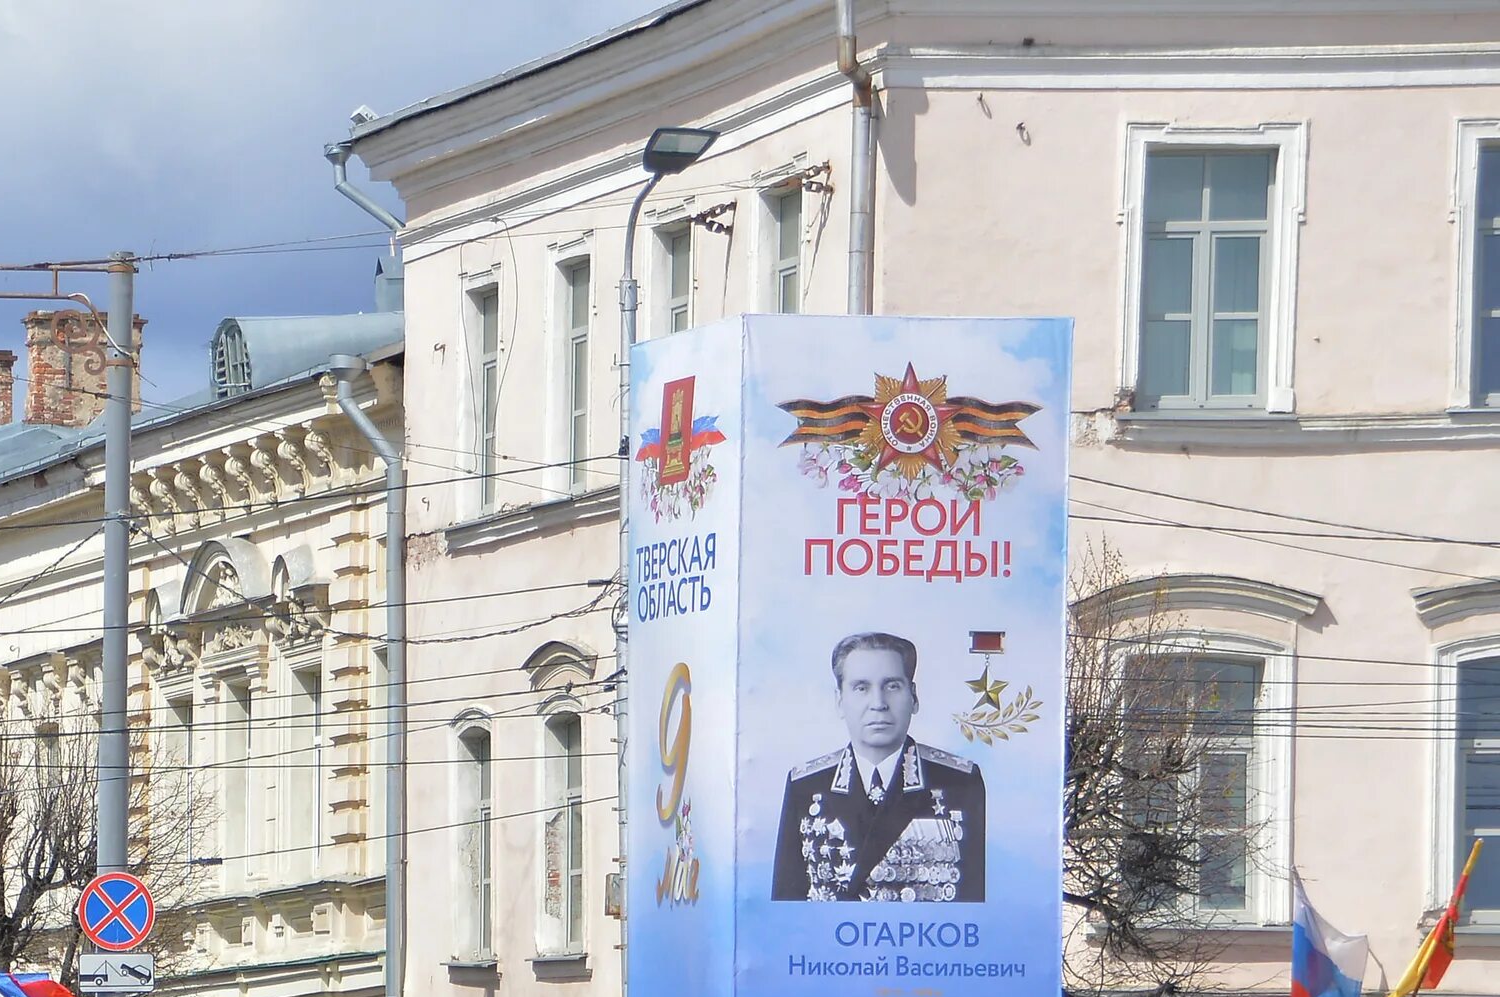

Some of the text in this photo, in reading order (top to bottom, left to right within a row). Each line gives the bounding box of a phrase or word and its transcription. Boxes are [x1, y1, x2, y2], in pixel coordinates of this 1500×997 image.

[882, 394, 932, 447] ОТЕЧЕСТВЕННАЯ
[836, 497, 981, 536] ГЕРОИ
[636, 532, 717, 584] ТВЕРСКАЯ
[804, 538, 1012, 583] ПОБЕДЫ!
[637, 574, 712, 623] ОБЛАСТЬ
[656, 662, 692, 823] 9
[834, 921, 980, 948] ОГАРКОВ
[788, 954, 1026, 978] Николай Васильевич
